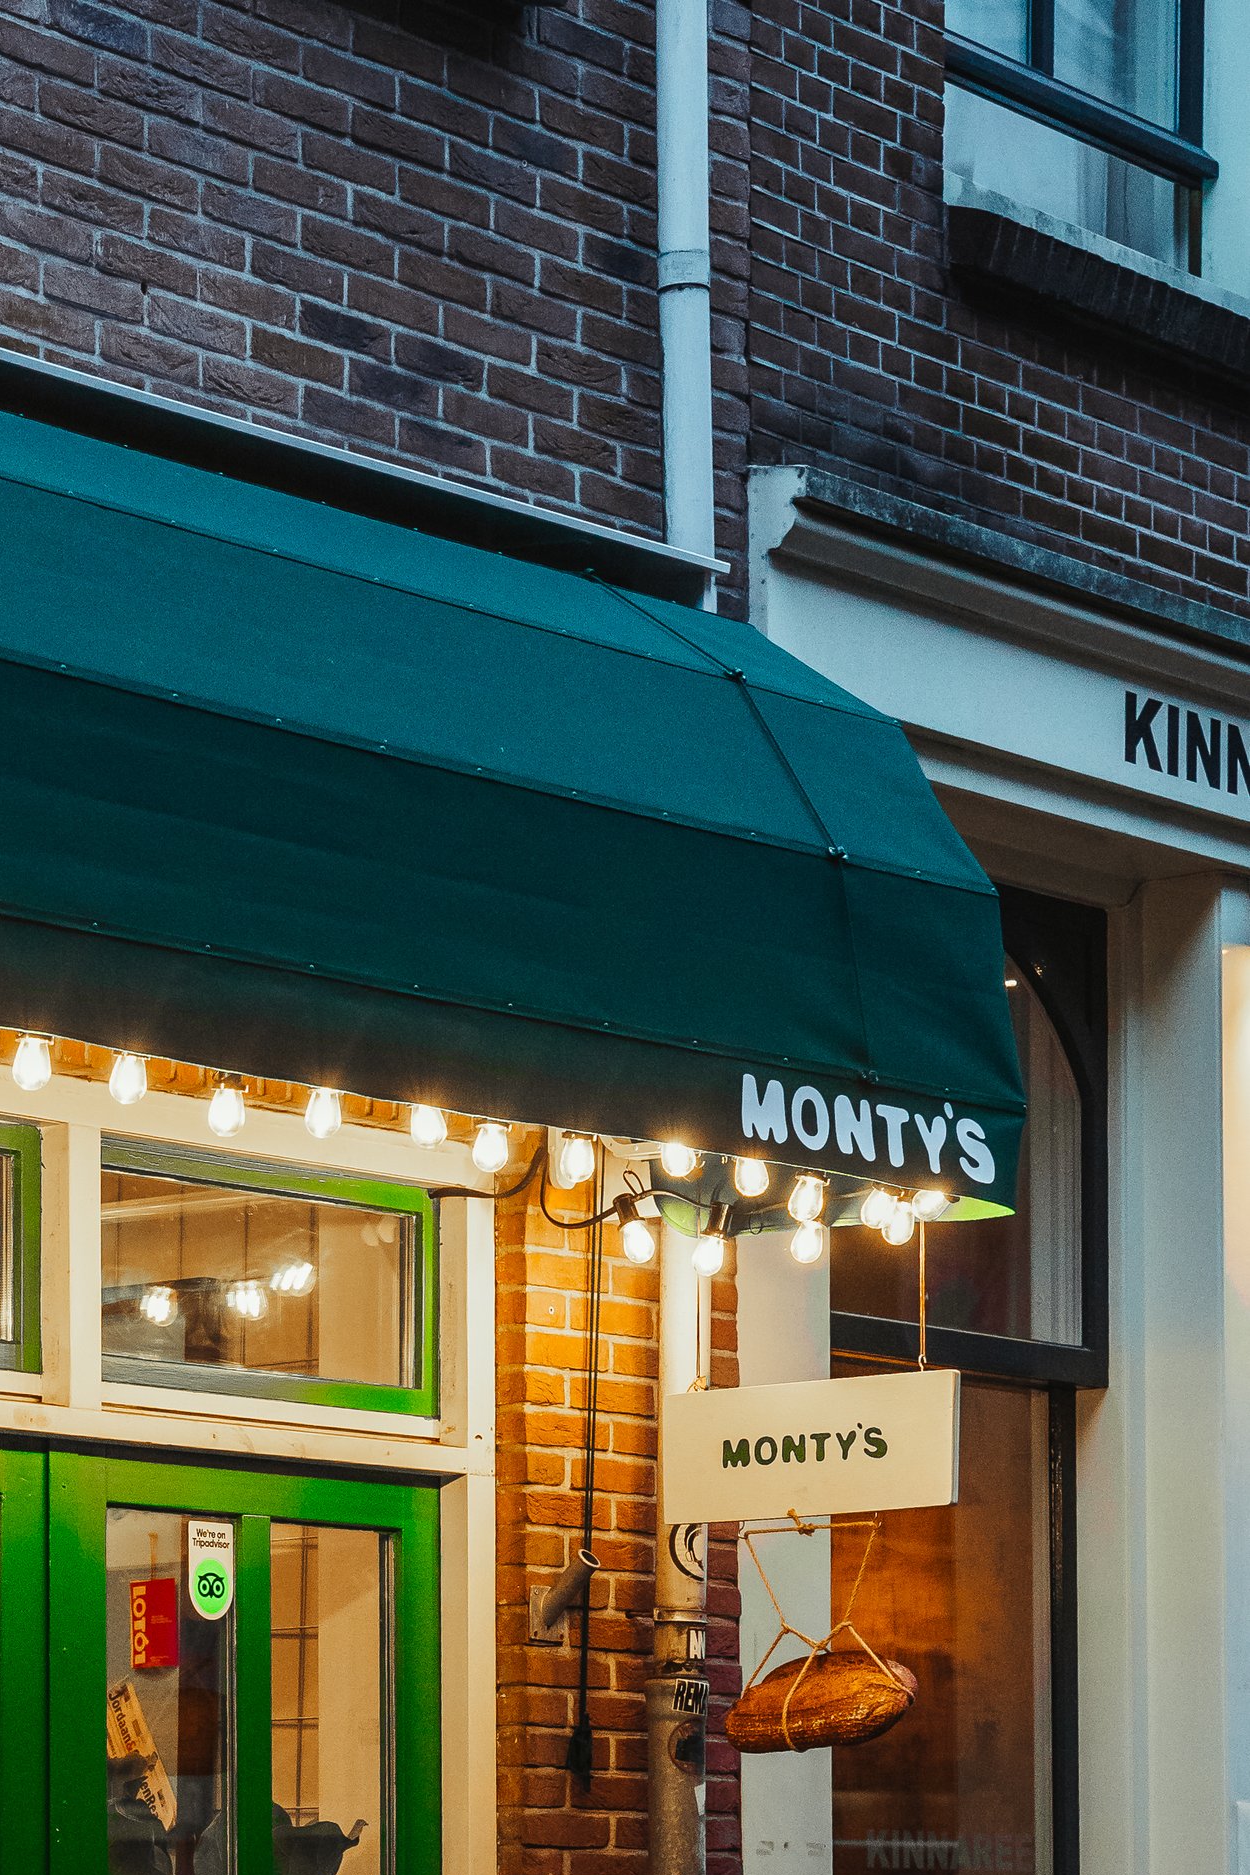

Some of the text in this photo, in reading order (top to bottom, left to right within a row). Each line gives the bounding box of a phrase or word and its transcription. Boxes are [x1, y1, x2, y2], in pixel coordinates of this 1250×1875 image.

[740, 1072, 996, 1185] MONTY'S
[721, 1422, 889, 1469] MONTY'S
[192, 1537, 230, 1549] Tripadvisor
[196, 1528, 226, 1540] We're on
